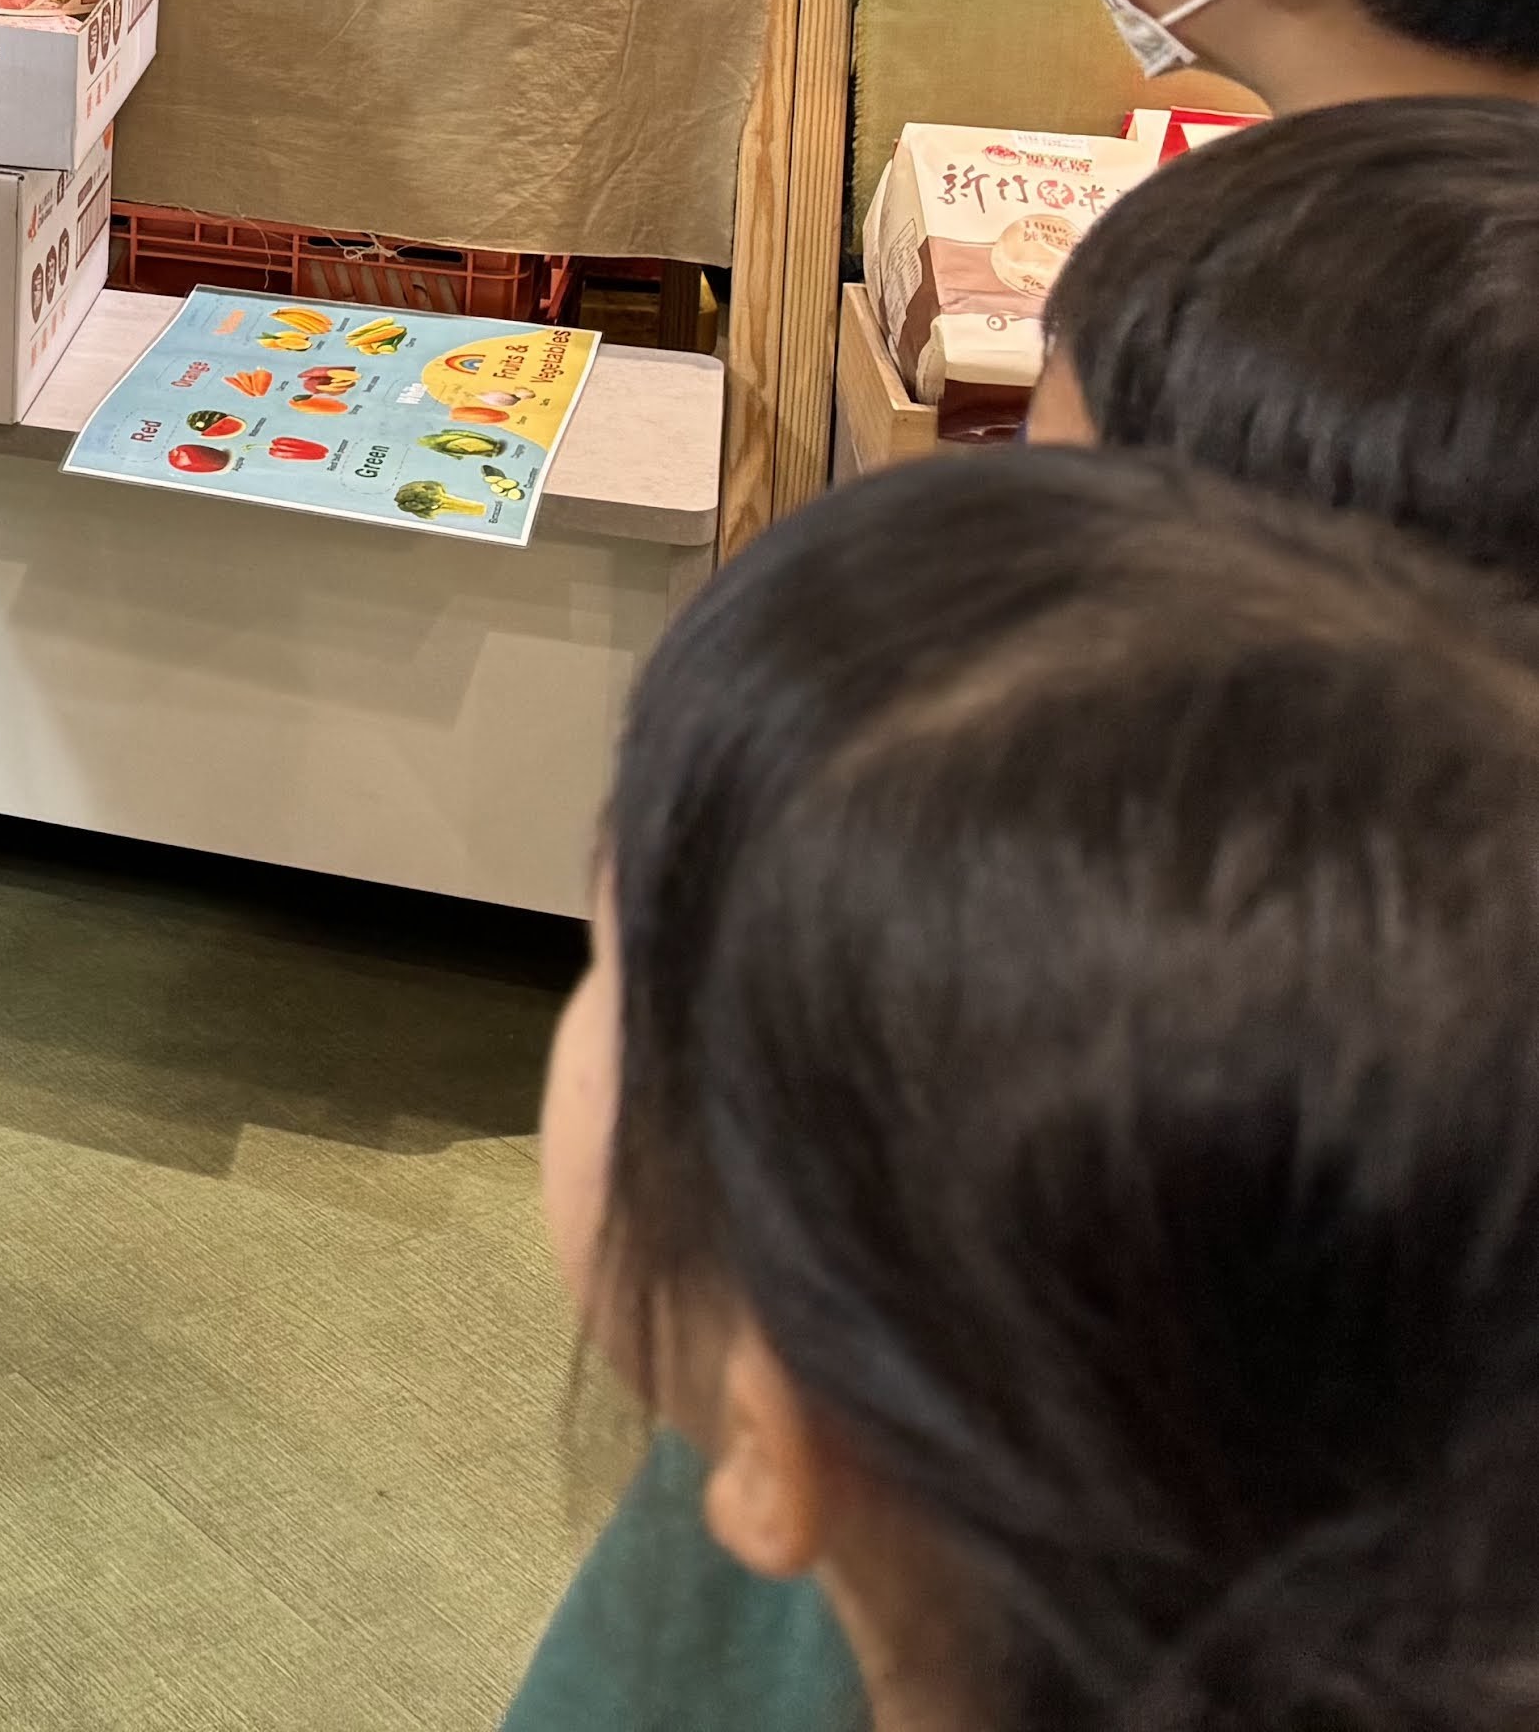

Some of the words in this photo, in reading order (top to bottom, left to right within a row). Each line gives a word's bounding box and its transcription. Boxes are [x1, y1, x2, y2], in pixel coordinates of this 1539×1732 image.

[505, 344, 529, 356] &
[530, 330, 572, 384] Vegetables
[170, 360, 210, 389] Orange
[493, 355, 526, 380] Fruits
[130, 420, 162, 444] Red
[355, 444, 390, 479] Green
